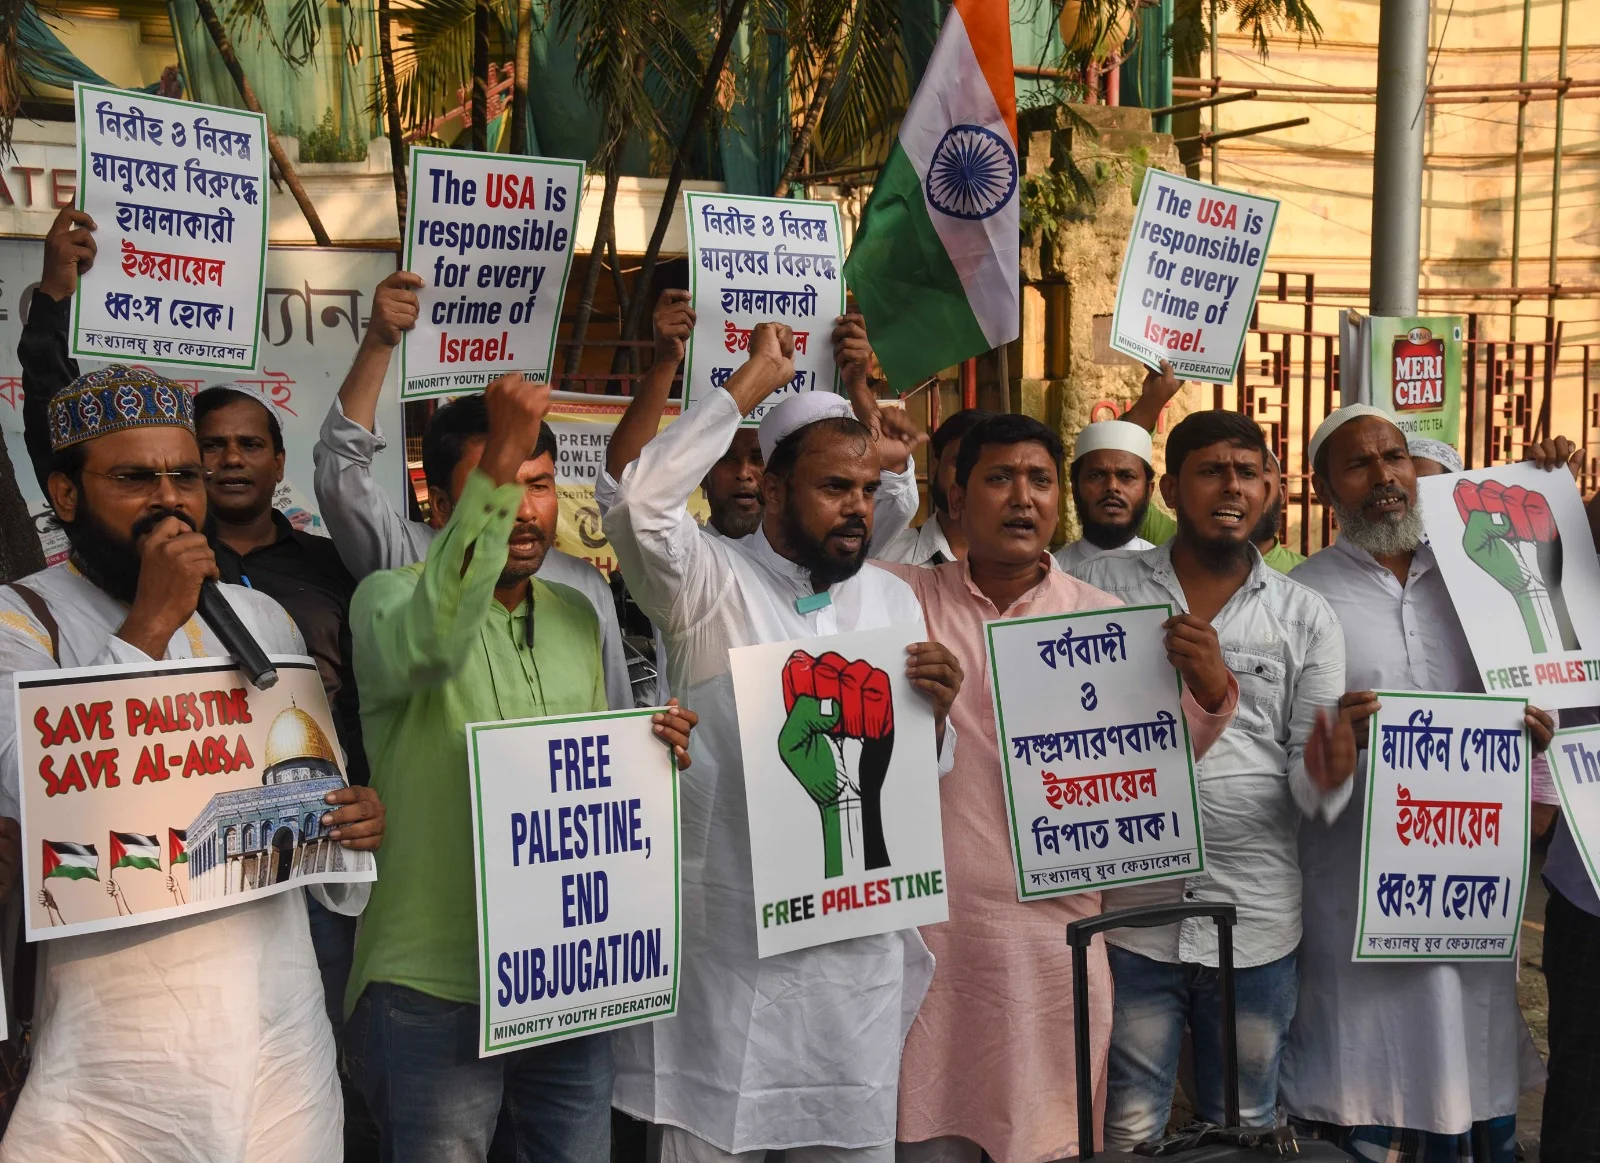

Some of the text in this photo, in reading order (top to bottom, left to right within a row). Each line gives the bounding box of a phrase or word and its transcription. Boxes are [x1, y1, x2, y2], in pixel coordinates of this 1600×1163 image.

[96, 101, 251, 161] নিরীহ ও নিরস্ত্র
[91, 152, 258, 205] মানুষের বিরুদ্ধে
[429, 169, 566, 212] The USA is
[116, 202, 235, 243] হামলাকারী
[702, 204, 827, 242] নিরীহ ও নিরস্ত্র
[1157, 186, 1263, 235] The USA is
[418, 219, 568, 255] responsible
[1140, 219, 1260, 267] responsible
[121, 238, 225, 287] ইজরায়েল
[434, 256, 546, 294] for every
[700, 244, 836, 281] মানুষের বিরুদ্ধে
[1147, 251, 1239, 300] for every
[105, 292, 162, 324] ধ্বংস
[432, 296, 536, 324] crime of
[721, 284, 818, 318] হামলাকারী
[1142, 288, 1229, 324] crime of
[153, 340, 173, 356] যুব
[178, 341, 246, 360] ফেডারেশন
[440, 332, 514, 363] Israel.
[1145, 316, 1205, 353] Israel.
[1118, 335, 1231, 377] MINORITY YOTH FEDERATION
[1395, 355, 1443, 381] MERI
[408, 372, 546, 390] MINORITY YOUTH FETION
[1395, 380, 1443, 406] CHAI
[554, 433, 613, 447] PREME
[1419, 419, 1431, 432] CTC
[1432, 418, 1443, 431] TEA
[555, 466, 597, 478] UND
[557, 488, 594, 499] esents
[1037, 623, 1126, 669] বর্ণবাদী
[1487, 659, 1600, 690] FREE PALESTI
[1081, 682, 1097, 711] ও
[34, 687, 253, 749] SAVE PALESTINE
[1011, 710, 1177, 766] সম্প্রসারণবাদী
[1381, 709, 1522, 774] মার্কিন পোষ্য
[39, 734, 254, 797] SAVE AL-AQSA
[548, 735, 611, 793] FREE
[1041, 768, 1157, 810] ইজরায়েল
[511, 799, 650, 866] PALESTINE,
[1031, 816, 1109, 856] নিপাত
[1396, 783, 1502, 849] ইজরায়েল
[1096, 864, 1116, 880] যুব
[1122, 853, 1191, 873] ফেডারেশন
[562, 871, 608, 928] END
[763, 870, 943, 928] FREE PALESTINE
[1377, 873, 1436, 918] ধ্বংস
[1425, 938, 1442, 952] যুব
[1446, 938, 1507, 949] ফেডারেশন
[497, 927, 669, 1008] SUBJUGATION.
[493, 992, 670, 1040] MINORITY YOUTH FEDERATION
